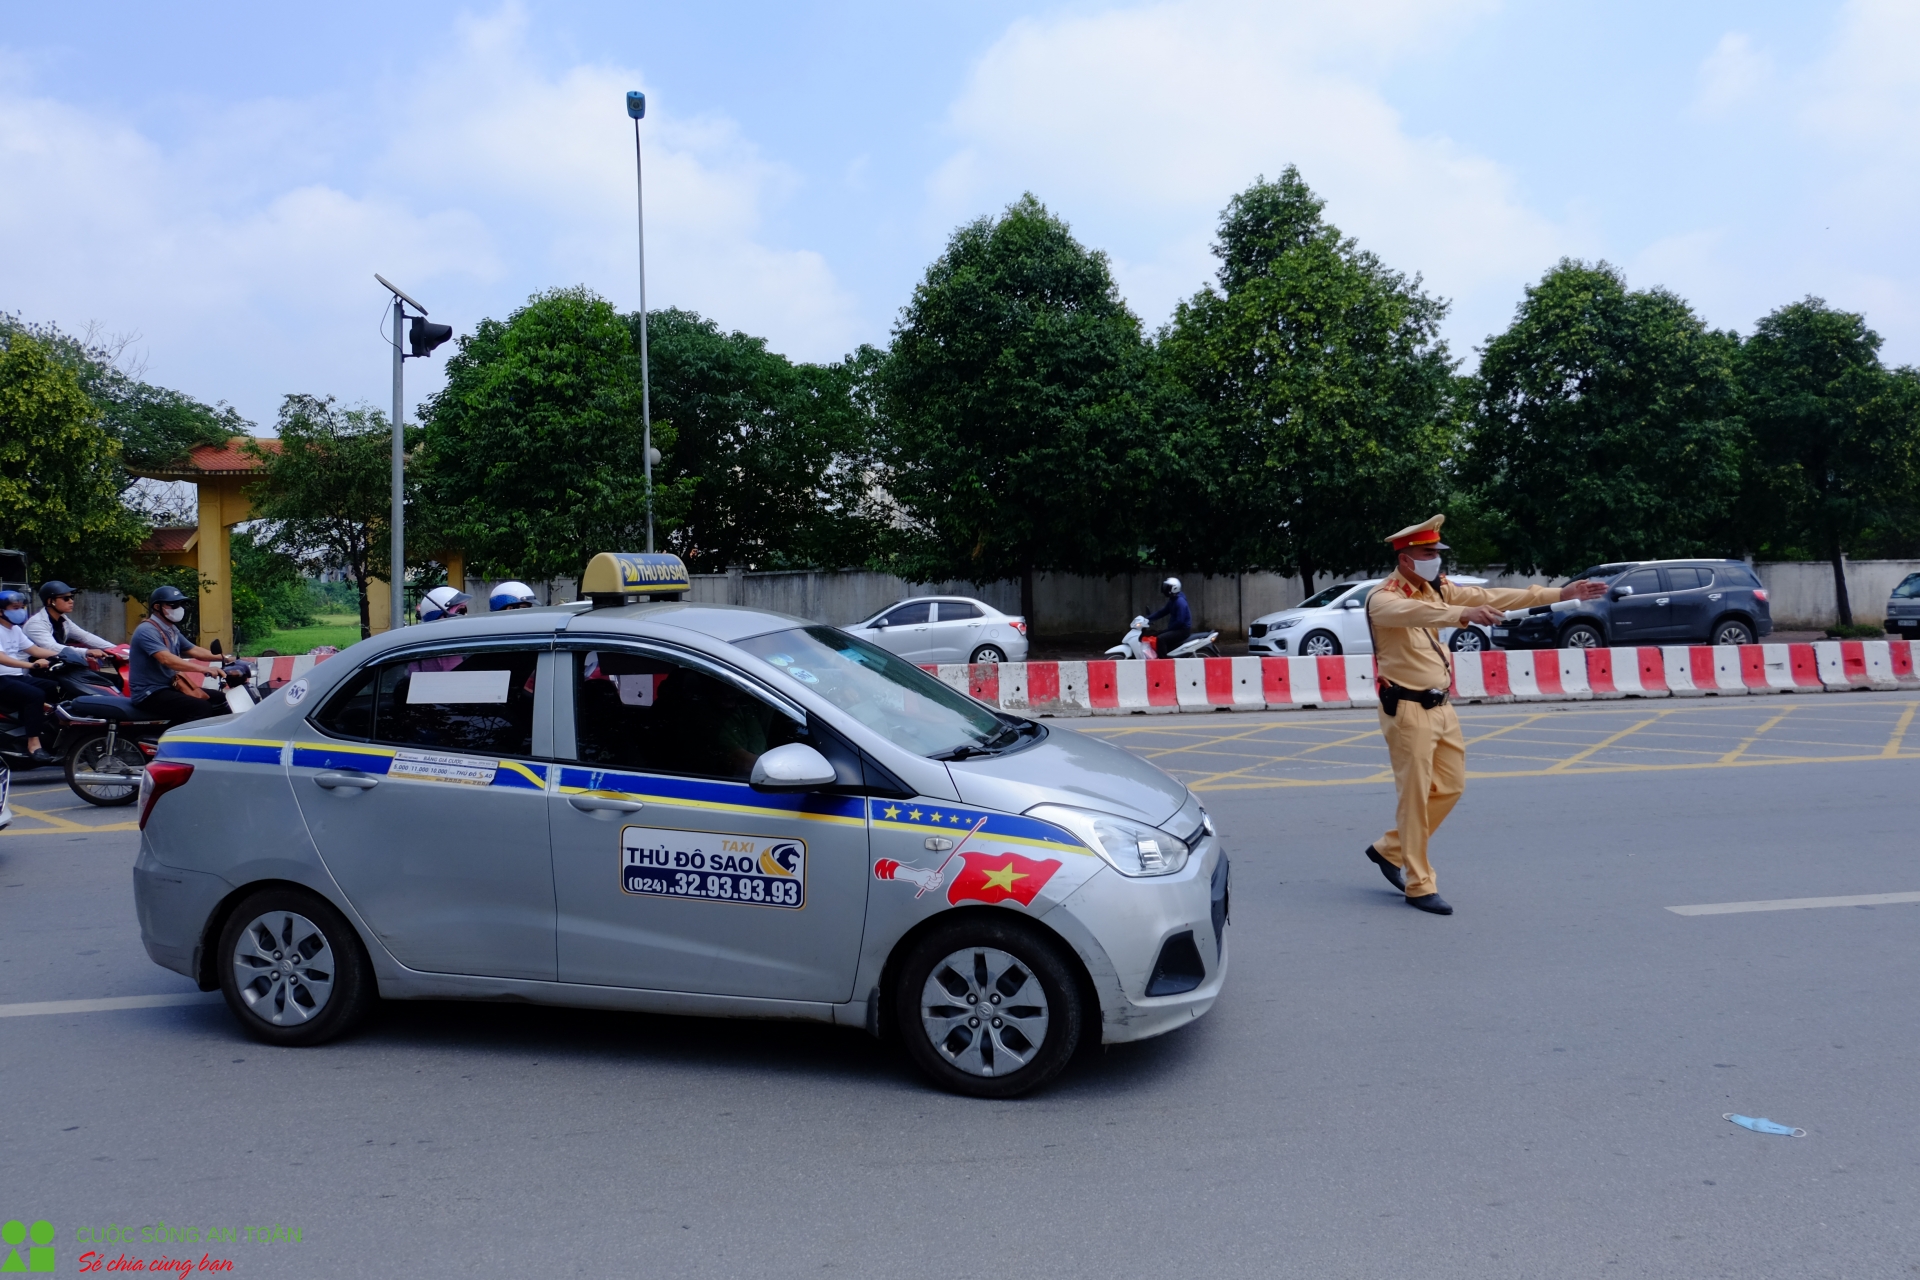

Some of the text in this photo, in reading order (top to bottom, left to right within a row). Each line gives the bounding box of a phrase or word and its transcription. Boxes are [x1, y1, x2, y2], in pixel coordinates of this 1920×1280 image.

[721, 840, 755, 853] TAXI
[626, 845, 754, 873] THỦ ĐÔ SAO
